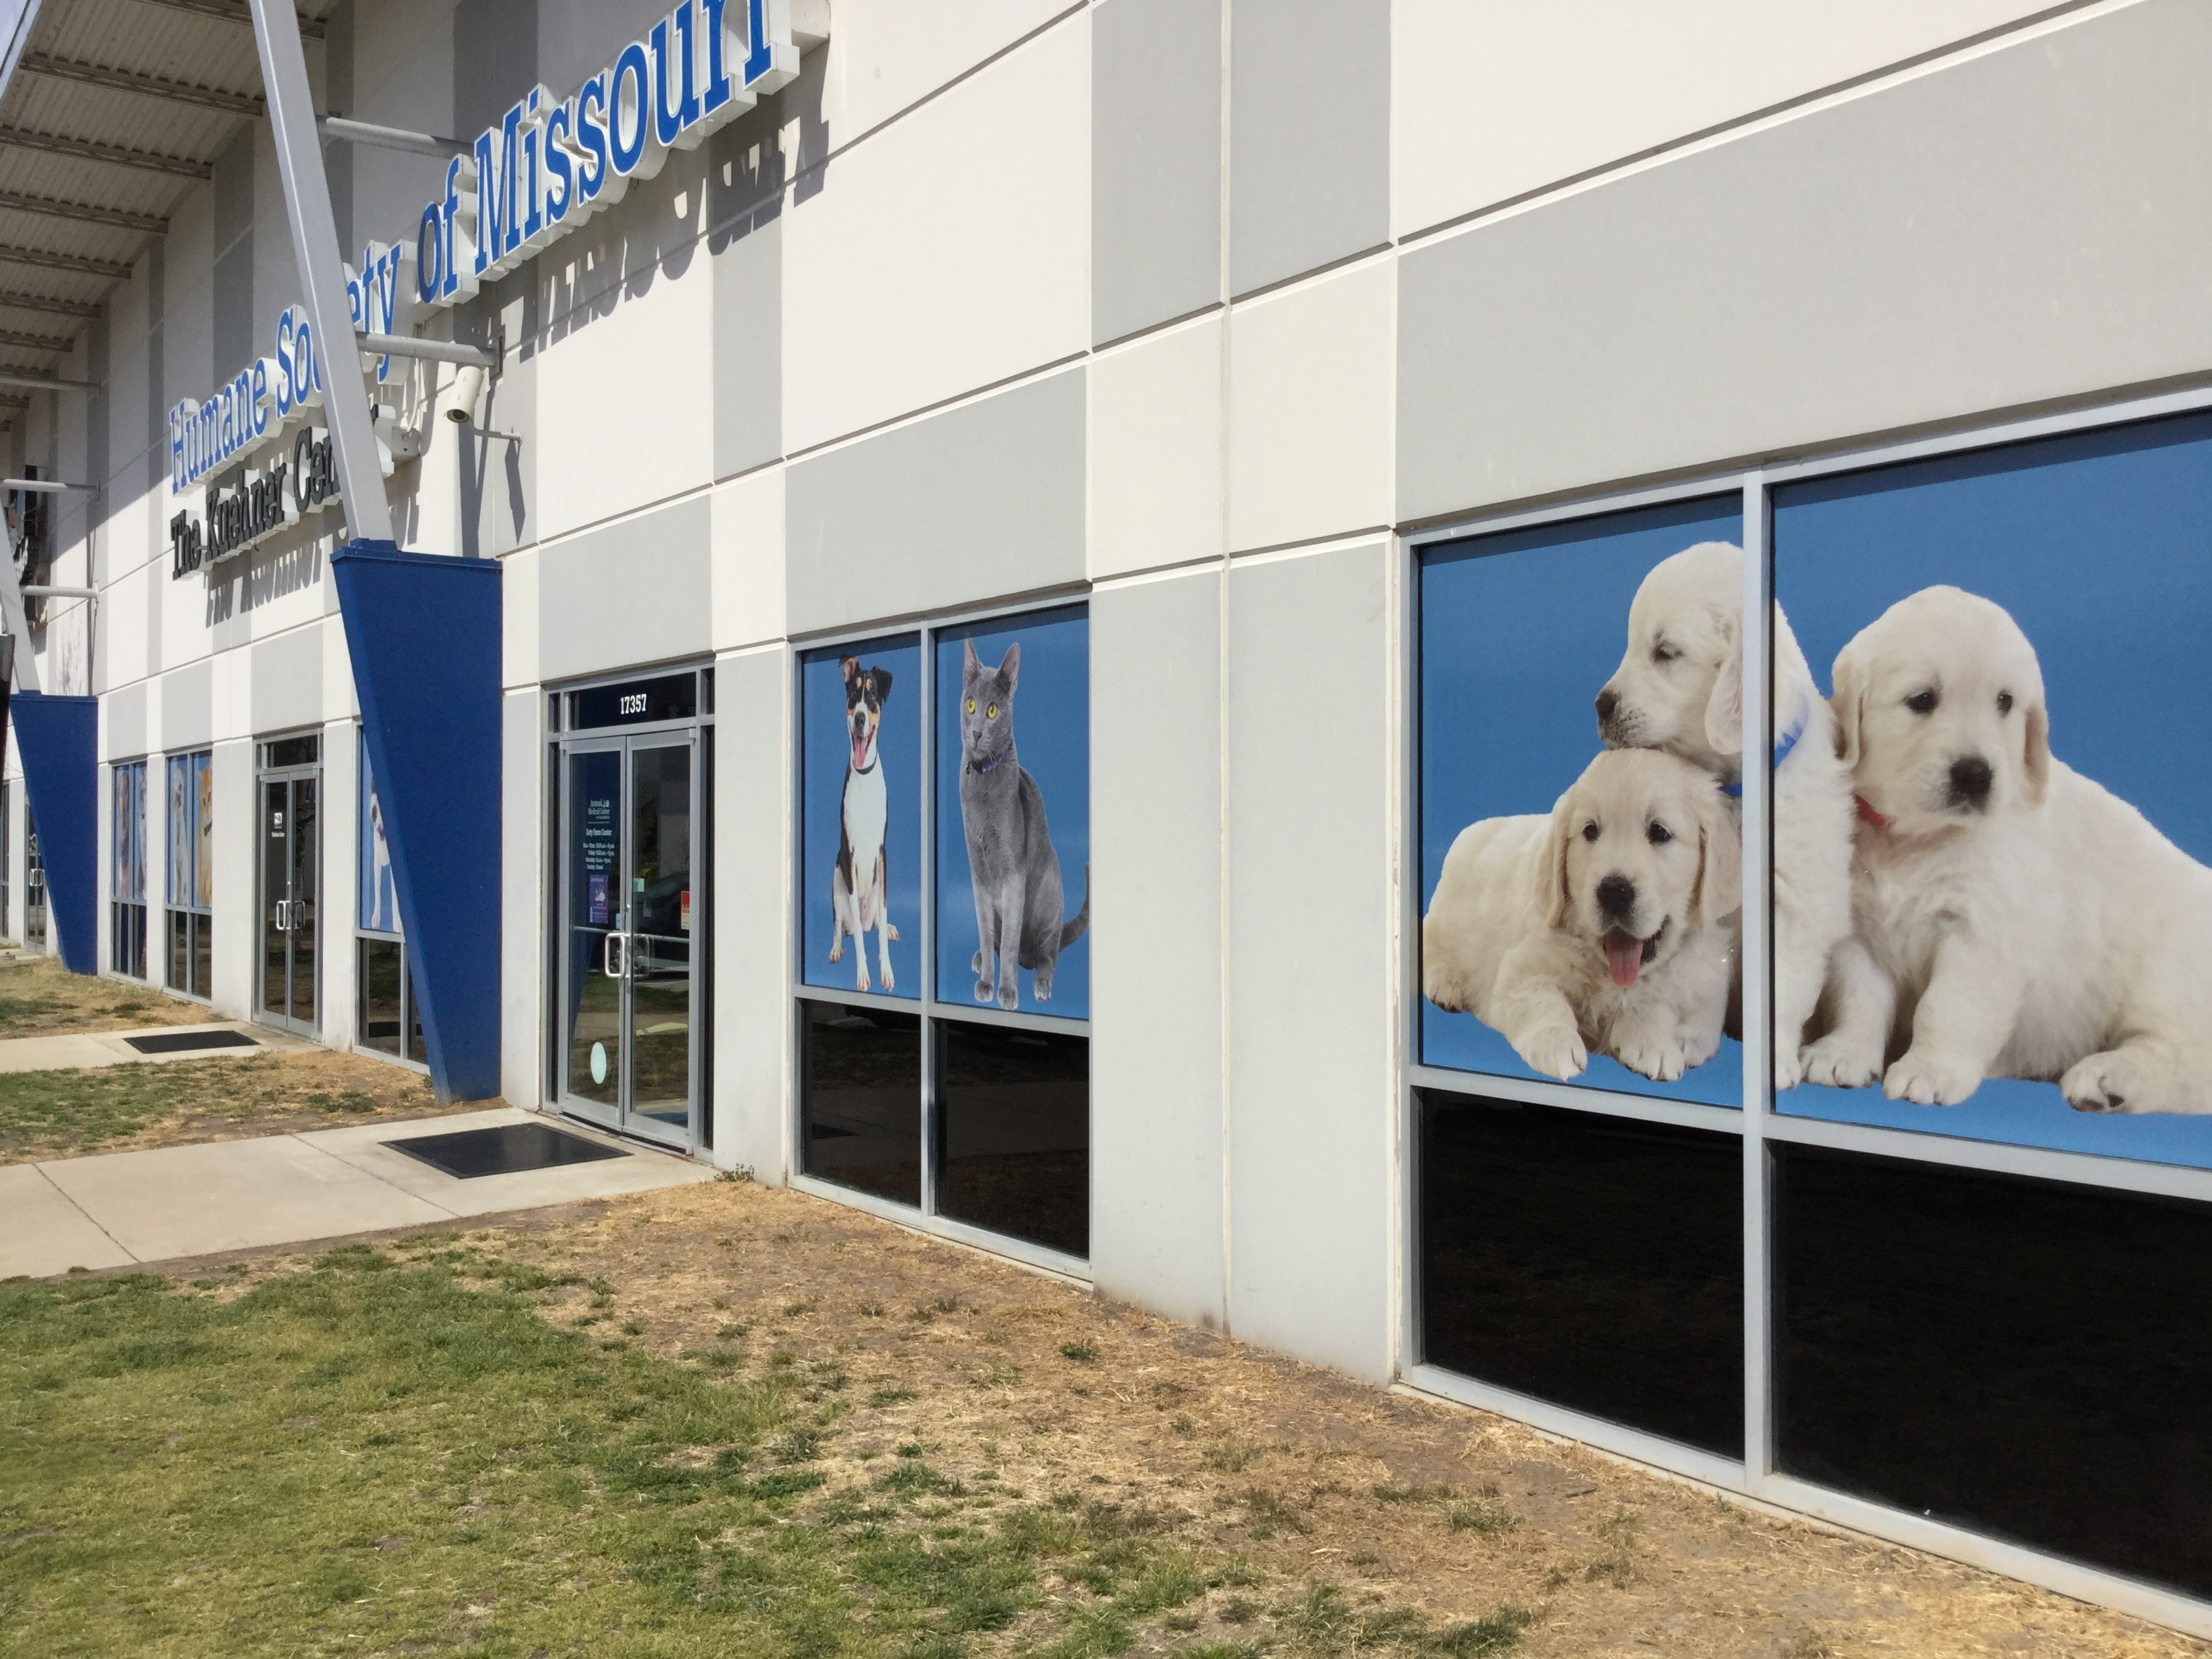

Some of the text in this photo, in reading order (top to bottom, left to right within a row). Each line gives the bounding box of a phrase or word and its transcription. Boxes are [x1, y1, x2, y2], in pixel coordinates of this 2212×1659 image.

[169, 356, 269, 495] Humane
[417, 154, 460, 304] of
[170, 508, 202, 581] The
[205, 462, 287, 562] Kuehner
[621, 693, 647, 714] 17357
